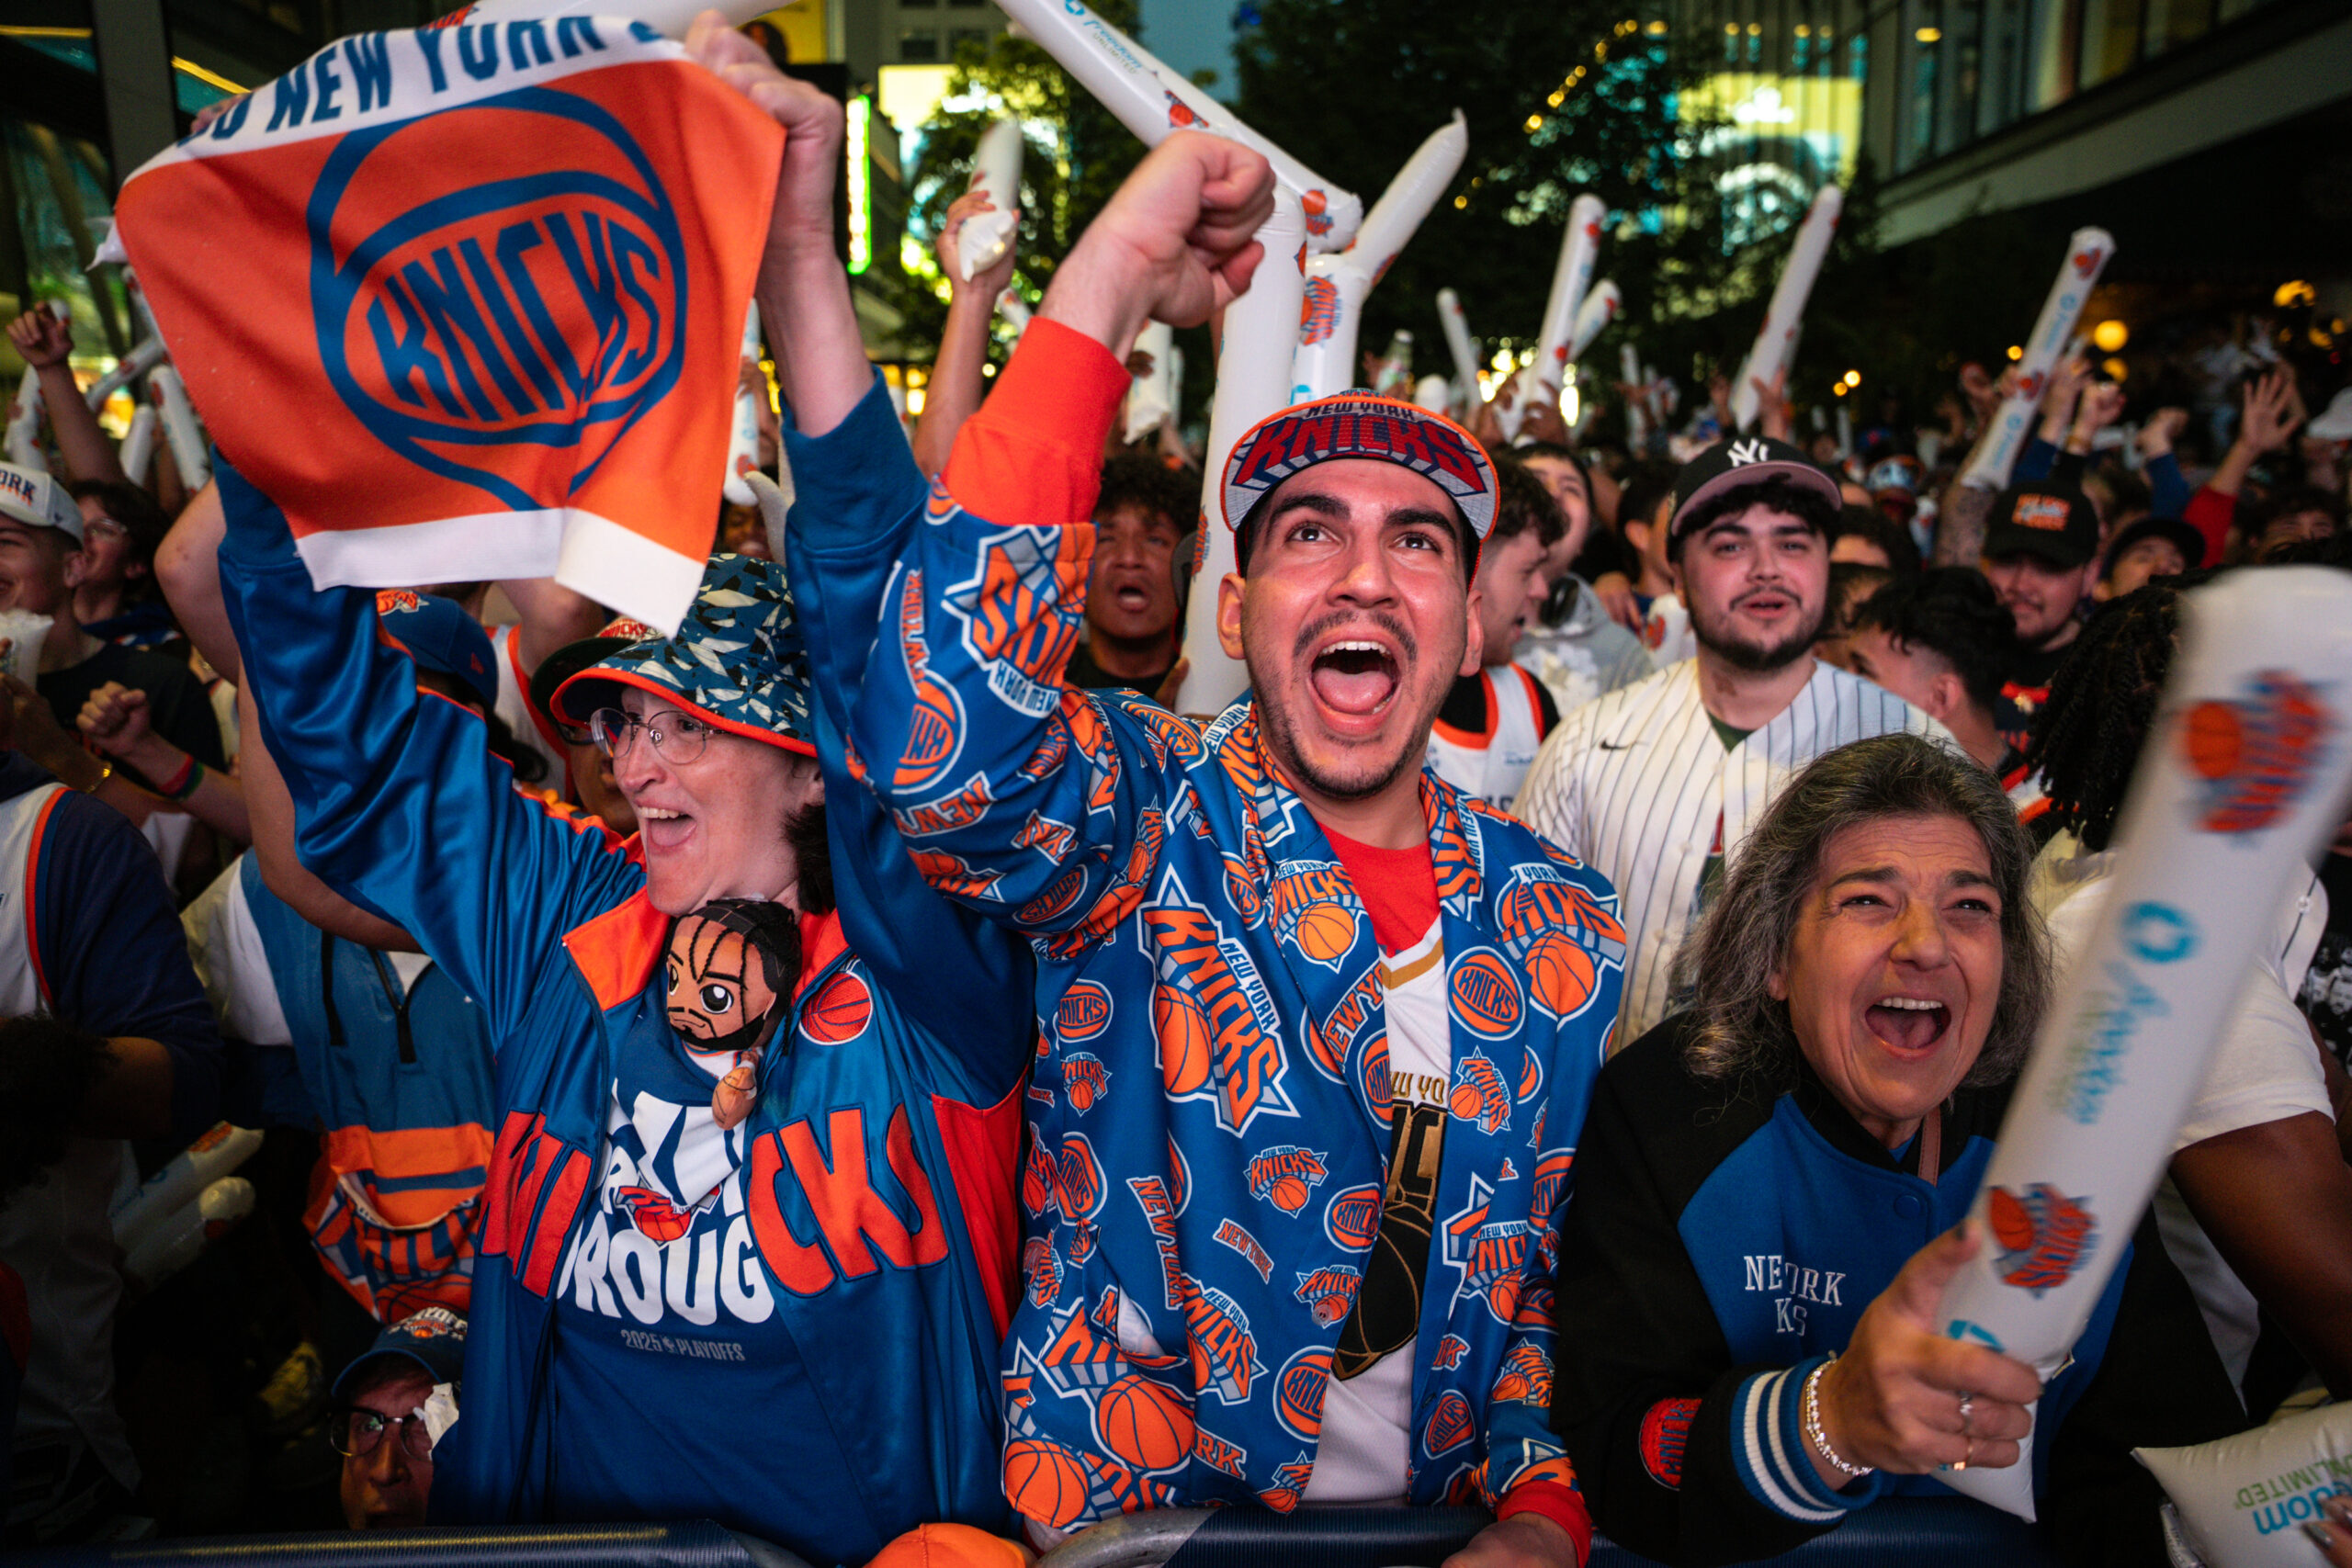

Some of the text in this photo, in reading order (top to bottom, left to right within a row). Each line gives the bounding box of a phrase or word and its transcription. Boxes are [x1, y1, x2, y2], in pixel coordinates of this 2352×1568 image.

[266, 31, 393, 135] NEW
[367, 210, 660, 423] KNICKS
[1306, 401, 1417, 422] NEW YORK
[1234, 413, 1487, 492] KNICKS
[1219, 942, 1251, 983] NEW
[1248, 977, 1278, 1031] YORK
[1458, 968, 1516, 1020] KNICKS
[1144, 909, 1280, 1129] KNICKS
[1463, 1059, 1510, 1133] KNICKS
[1250, 1150, 1327, 1193] KNICKS
[1133, 1179, 1177, 1238] NEW
[1217, 1222, 1272, 1281] NEW YORK
[1204, 1290, 1247, 1333] NEW YORK
[620, 1329, 746, 1361] 2025 PLAYOFFS
[1195, 1428, 1242, 1477] RK
[1430, 1401, 1468, 1450] KNICKS
